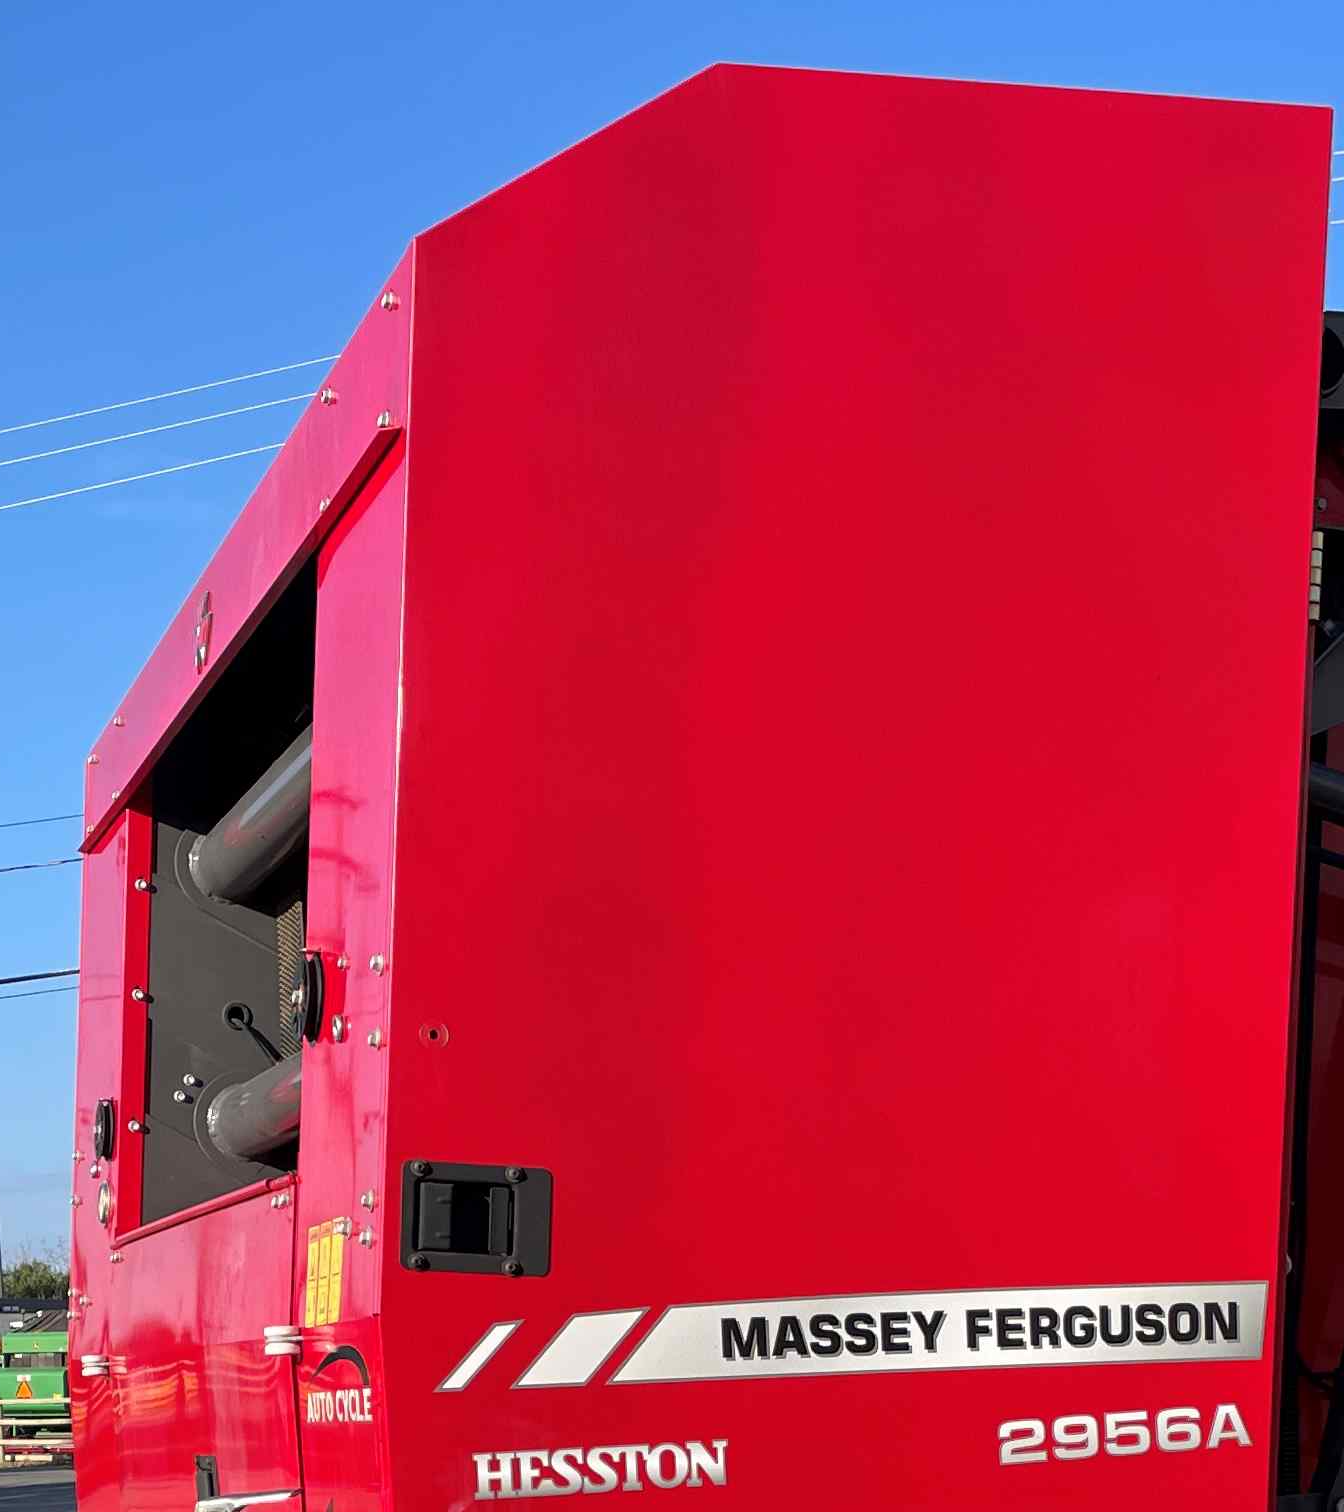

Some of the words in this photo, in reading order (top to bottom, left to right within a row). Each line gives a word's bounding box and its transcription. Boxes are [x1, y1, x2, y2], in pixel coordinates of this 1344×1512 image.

[721, 1309, 945, 1362] MASSEY
[965, 1300, 1241, 1351] FERGUSON
[307, 1391, 334, 1423] AUTO
[335, 1386, 373, 1423] CYCLE
[997, 1405, 1253, 1467] 2956A
[472, 1440, 728, 1501] HESSTON
